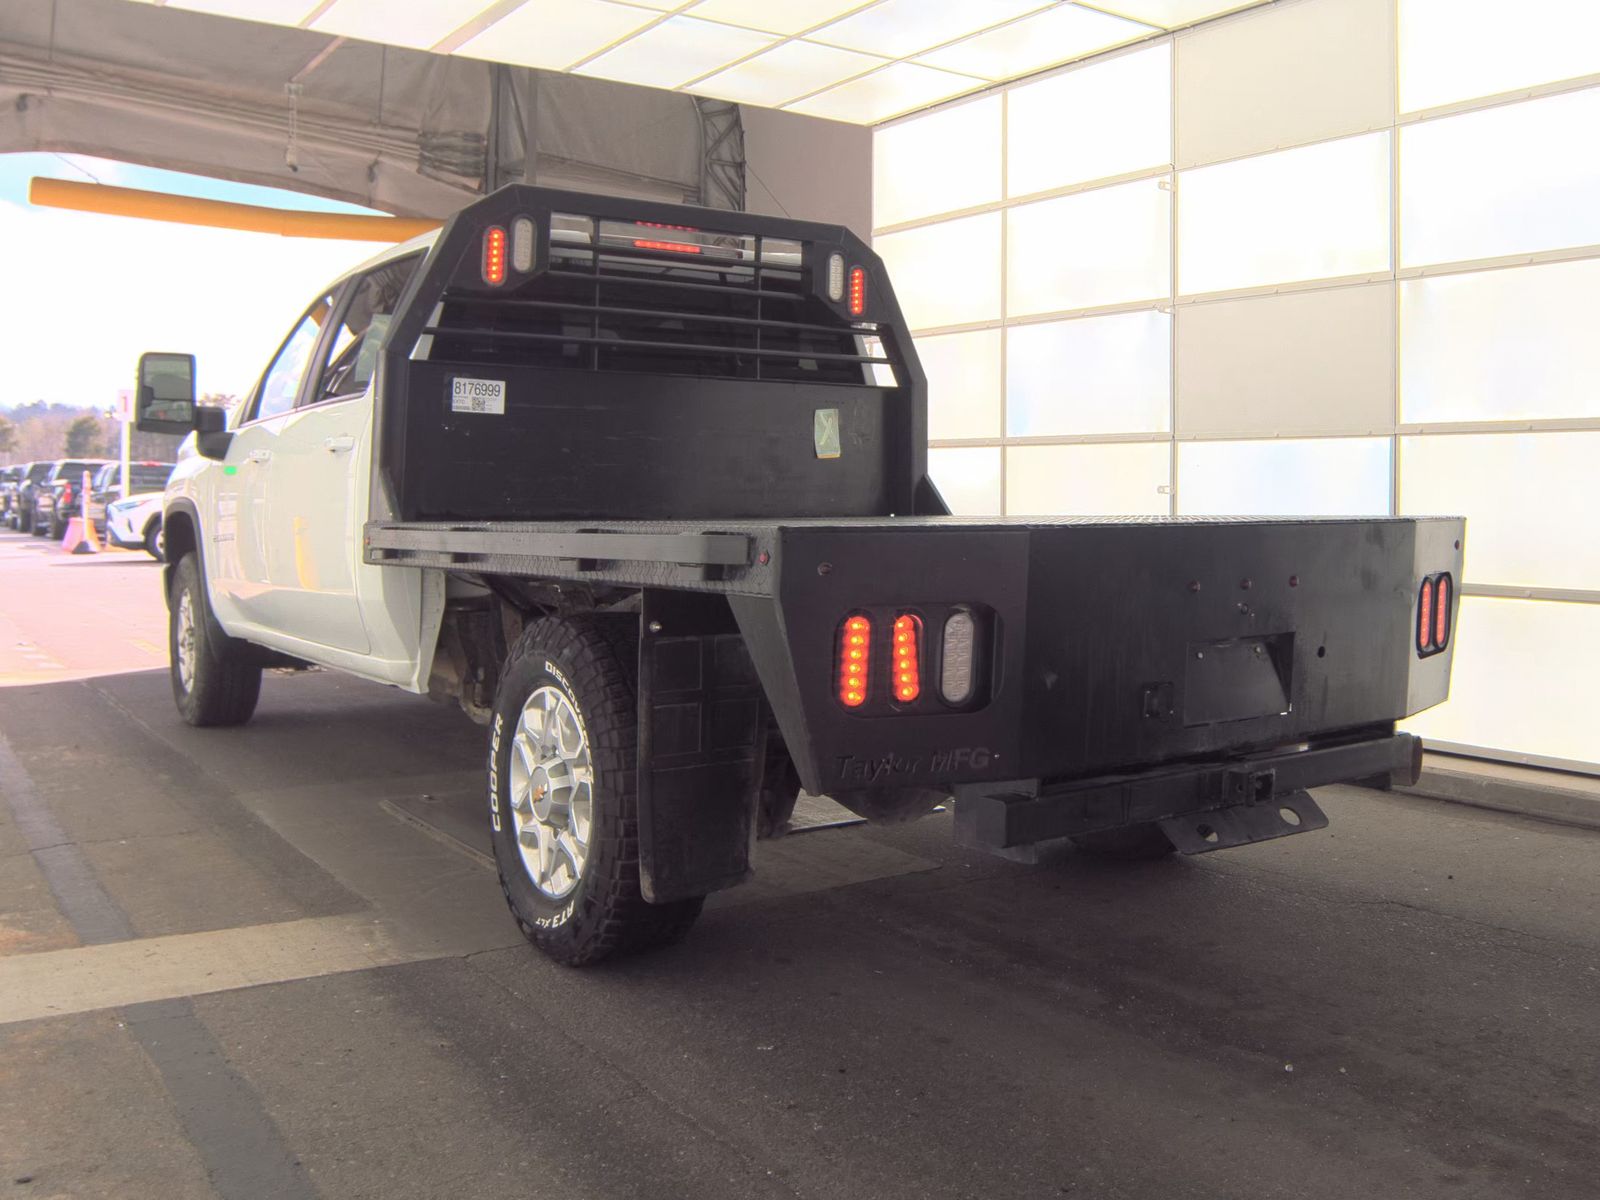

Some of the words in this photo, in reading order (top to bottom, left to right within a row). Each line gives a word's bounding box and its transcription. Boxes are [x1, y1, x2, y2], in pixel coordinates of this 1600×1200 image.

[454, 381, 501, 397] 8176999
[490, 713, 503, 832] COOPER
[930, 747, 990, 773] MFG
[551, 899, 575, 929] AT3
